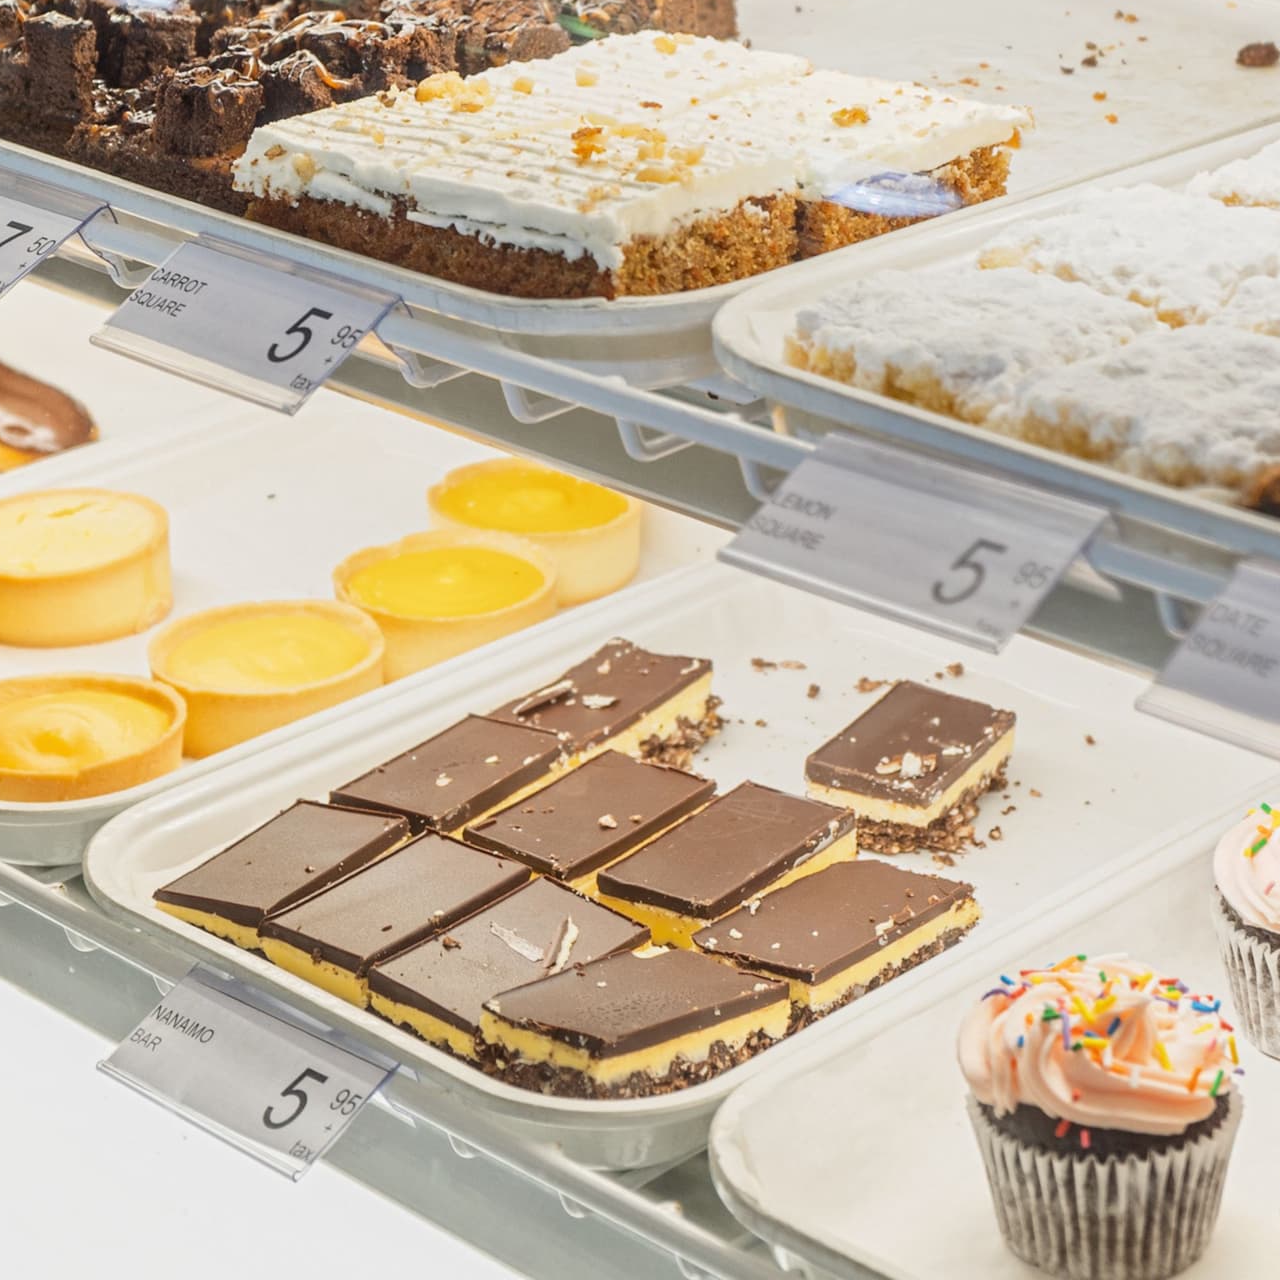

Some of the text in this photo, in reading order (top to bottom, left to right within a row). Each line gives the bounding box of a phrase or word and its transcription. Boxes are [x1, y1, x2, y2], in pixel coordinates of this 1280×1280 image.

[27, 237, 55, 255] 50
[151, 266, 208, 296] CARROT
[129, 289, 187, 318] SQUARE
[266, 307, 364, 363] 5 95
[289, 373, 314, 392] tax
[771, 491, 837, 520] LEMON
[751, 516, 825, 551] SQUARE
[931, 538, 1055, 605] 5 95
[1208, 602, 1270, 638] DATE
[1188, 633, 1280, 678] SQUARE
[129, 1028, 162, 1052] BAR
[152, 1005, 215, 1044] NANAIMO
[262, 1068, 362, 1129] 5 95
[289, 1139, 313, 1162] tax
